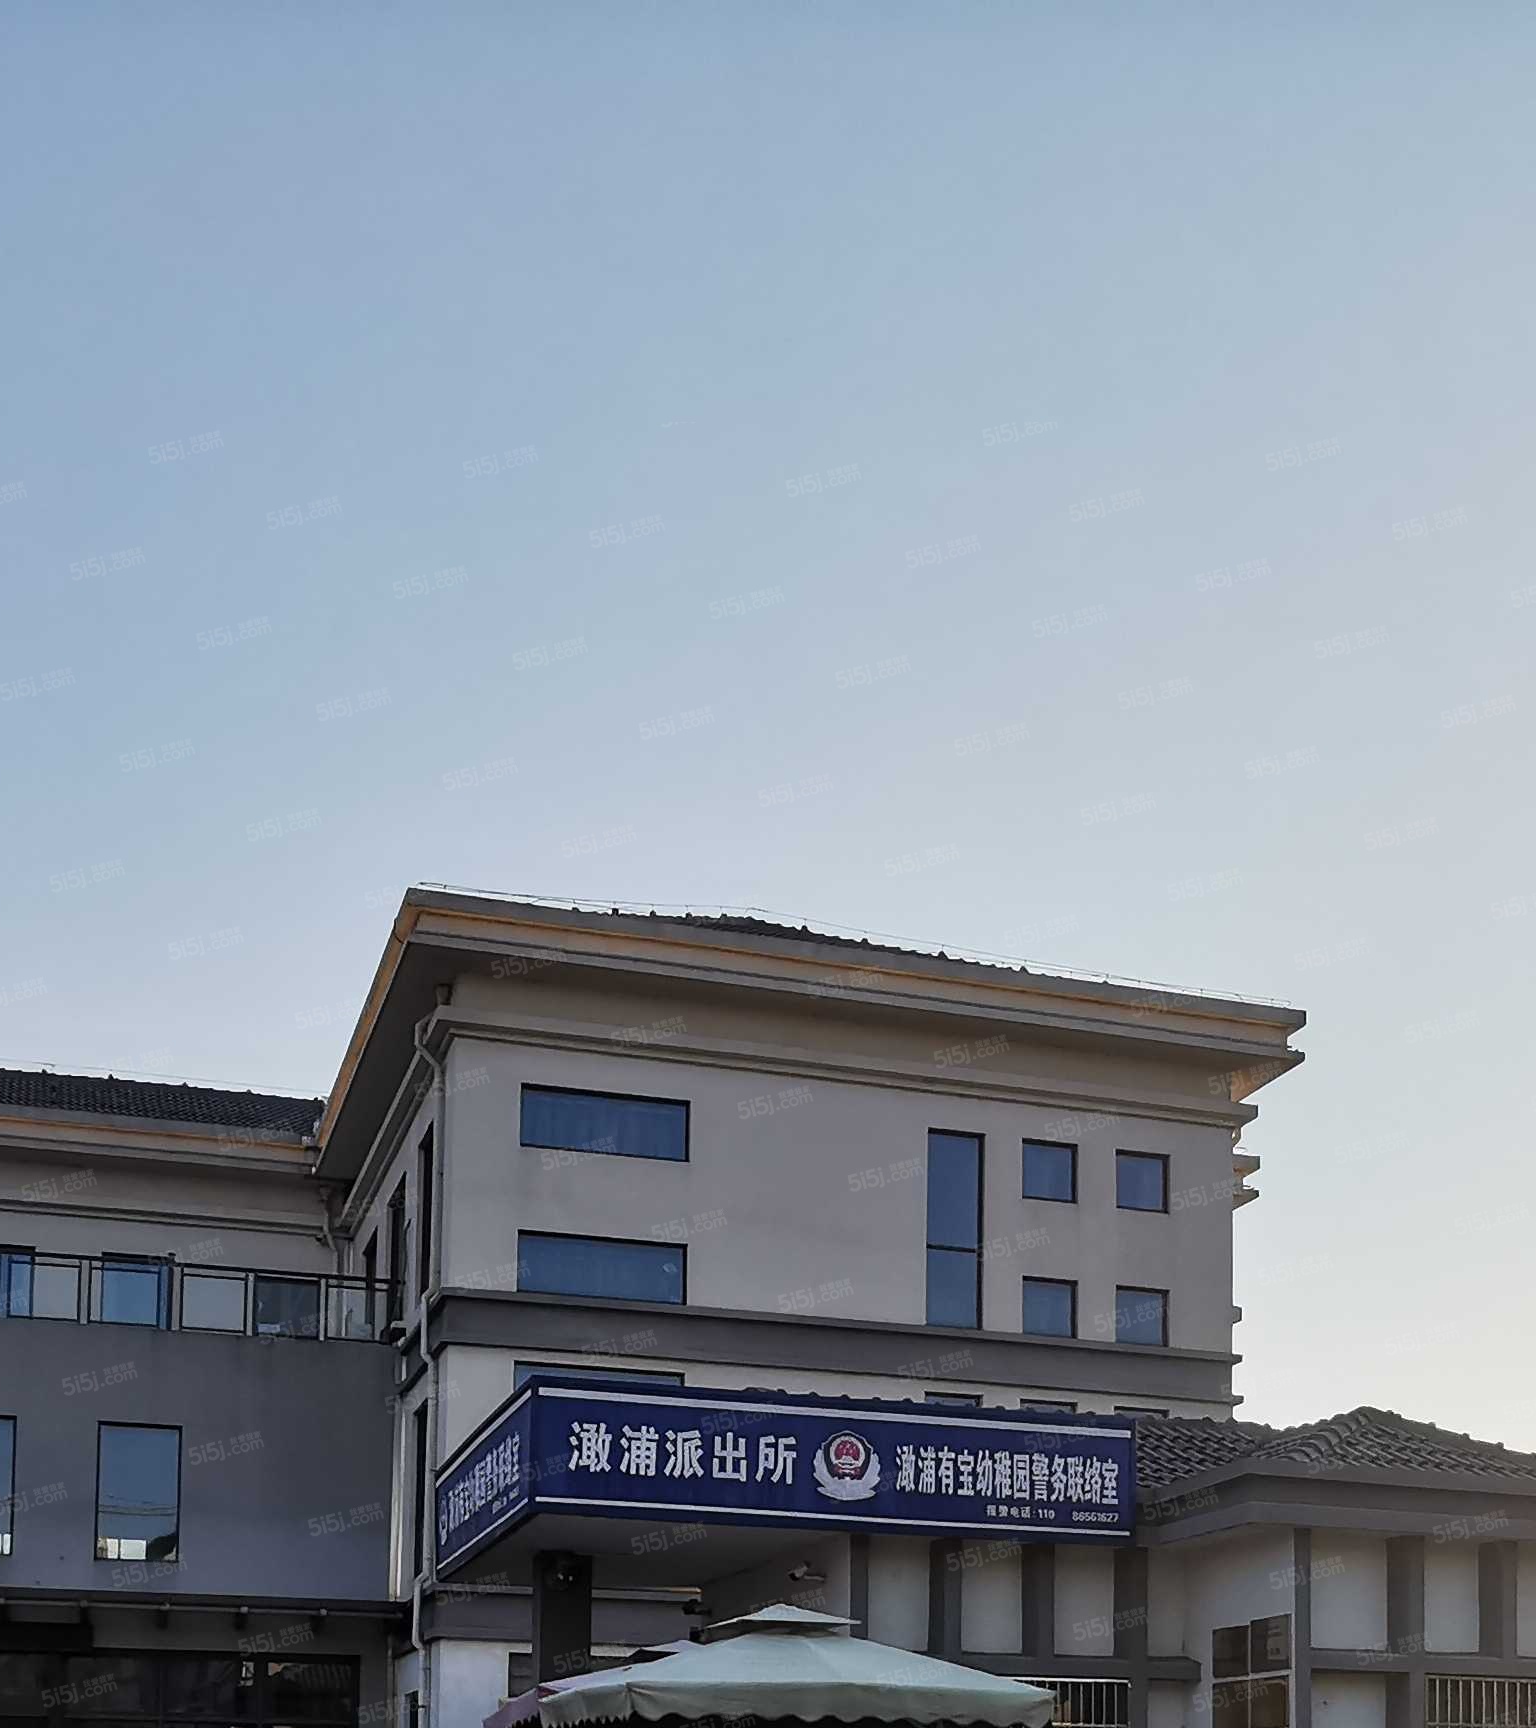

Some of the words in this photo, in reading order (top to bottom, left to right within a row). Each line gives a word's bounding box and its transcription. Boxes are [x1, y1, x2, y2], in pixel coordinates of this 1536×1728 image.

[568, 1421, 799, 1485] 澉浦派出所
[896, 1445, 1119, 1505] 澉浦有宝幼稚园警务联络室
